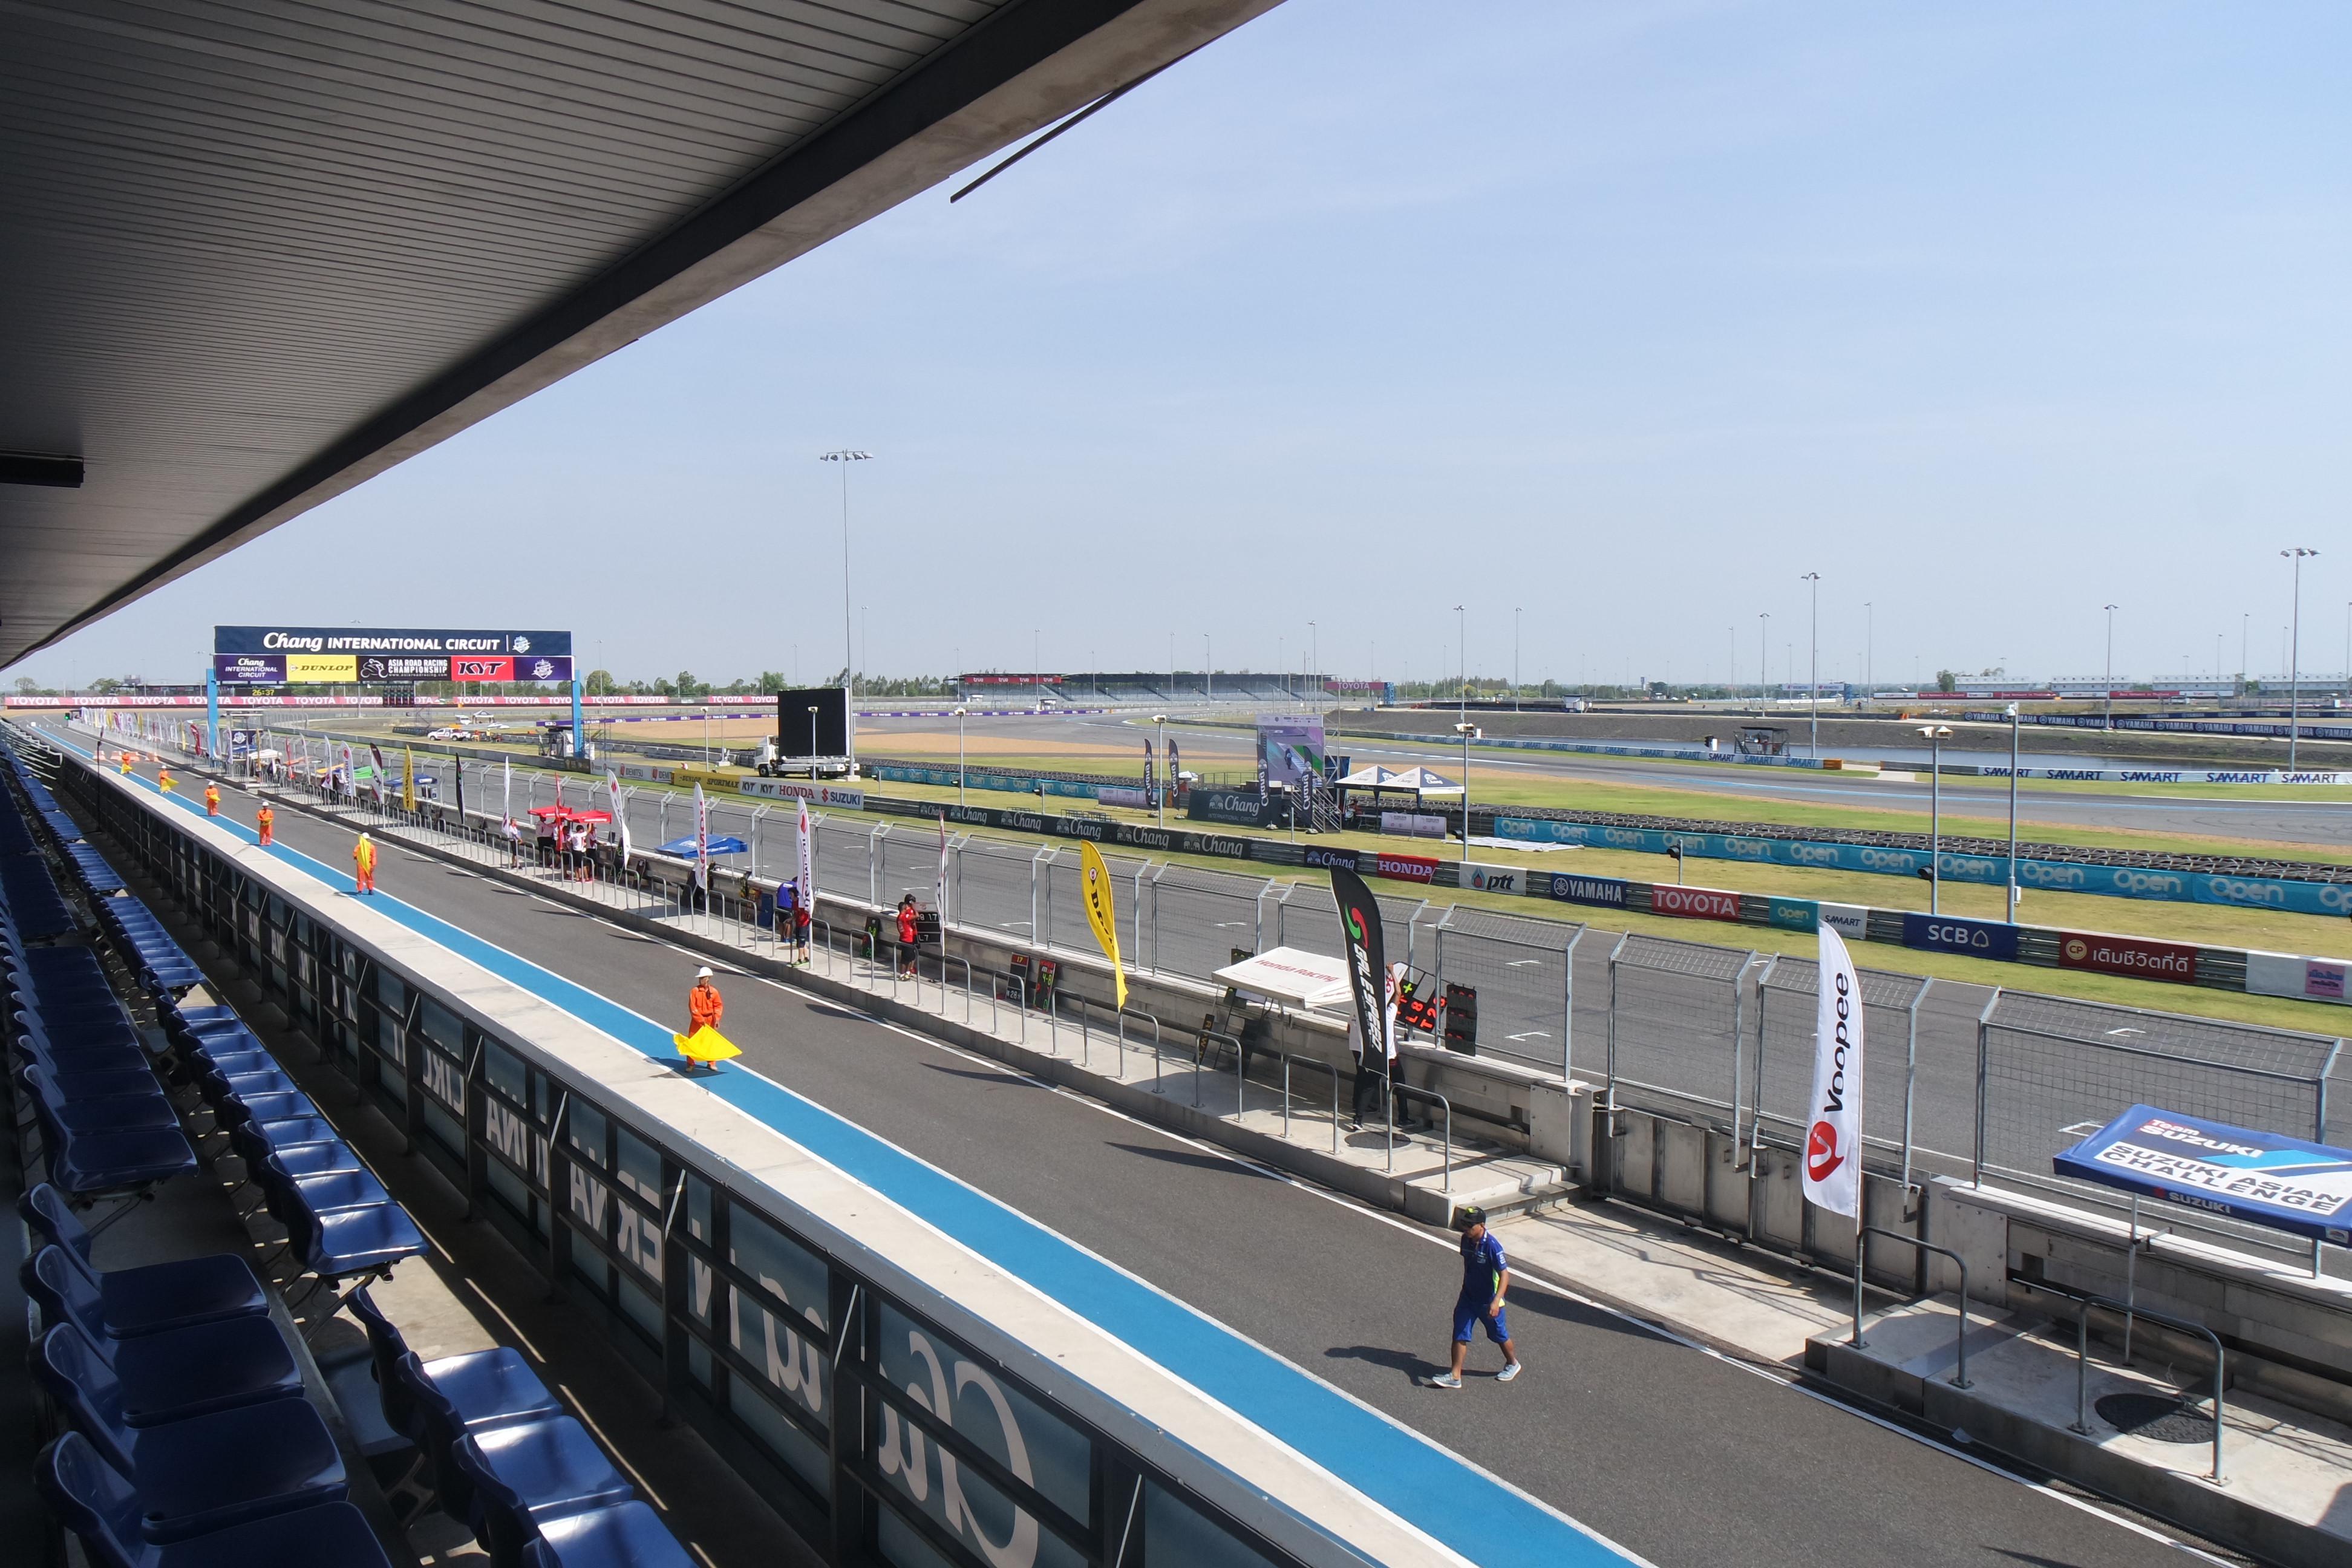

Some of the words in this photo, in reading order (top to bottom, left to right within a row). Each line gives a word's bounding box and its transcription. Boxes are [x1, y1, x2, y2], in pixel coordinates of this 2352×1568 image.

[263, 632, 322, 652] Chang
[327, 637, 442, 650] INTERNATIONAL
[445, 638, 500, 650] CIRCUIT
[238, 658, 265, 666] Chang
[457, 661, 507, 675] KYT
[11, 697, 60, 705] TOYOTA
[130, 696, 176, 705] TOYOTA
[1972, 713, 1999, 721] YAMAHA
[2047, 716, 2075, 726] YAMAHA
[2125, 720, 2154, 730] YAMAHA
[2164, 721, 2194, 731] YAMAHA
[2204, 722, 2233, 732] YAMAHA
[2244, 724, 2275, 734] YAMAHA
[2284, 726, 2313, 736] YAAHA
[1640, 748, 1664, 757] SAMART
[1674, 750, 1701, 760] SAMART
[1708, 752, 1736, 762] SAMART
[1743, 755, 1774, 765] SAMART
[1785, 757, 1818, 768] SAMART
[626, 768, 643, 777] IDEMITSU
[2047, 769, 2104, 781] SAMART
[2120, 771, 2181, 783] SAMART
[2206, 772, 2270, 783] SAMART
[2282, 773, 2339, 784] SAMART
[707, 777, 739, 789] SPORTMAX
[742, 780, 756, 791] KYT
[760, 783, 774, 794] KYT
[779, 785, 815, 799] HONDA
[831, 791, 860, 806] SUZUKI
[1224, 796, 1259, 816] Chang
[961, 805, 987, 825] Chang
[1013, 811, 1042, 831] Chang
[1207, 813, 1239, 822] INTERNATIONAL
[1070, 818, 1102, 841] Chang
[1501, 818, 1535, 836] Open
[1551, 822, 1588, 840] Open
[1604, 827, 1645, 844] Open
[1132, 826, 1169, 849] Chang
[1201, 834, 1243, 858] Chang
[1662, 832, 1705, 851] Open
[1725, 837, 1771, 857] Open
[1791, 843, 1839, 863] Open
[1321, 851, 1356, 869] Chang
[1861, 848, 1914, 869] Open
[1938, 854, 1995, 876] Open
[1377, 860, 1434, 877] HONDA
[2022, 862, 2084, 884] Open
[1486, 873, 1515, 890] ptt
[2113, 869, 2182, 893] Open
[1569, 879, 1622, 903] YAMAHA
[2209, 877, 2284, 903] Open
[1654, 889, 1737, 916] TOYOTA
[2319, 886, 2352, 913] Op
[1778, 906, 1809, 920] Open
[1824, 915, 1861, 927] SAMART
[1928, 924, 1969, 944] SCB
[2069, 945, 2083, 954] CP
[1353, 943, 1374, 994] GALE
[2092, 947, 2189, 973] เติมชีวิตที่ดี
[1255, 959, 1297, 973] Honda
[1295, 968, 1340, 982] Racing
[1363, 988, 1382, 1053] SPEED
[2149, 1119, 2200, 1137] Team
[2139, 1124, 2265, 1157] SUZUKI
[2102, 1151, 2335, 1212] CHALLENGE
[2109, 1145, 2229, 1180] SUZUKI
[2235, 1176, 2345, 1203] ASIAN
[2168, 1192, 2232, 1215] SUZUKI
